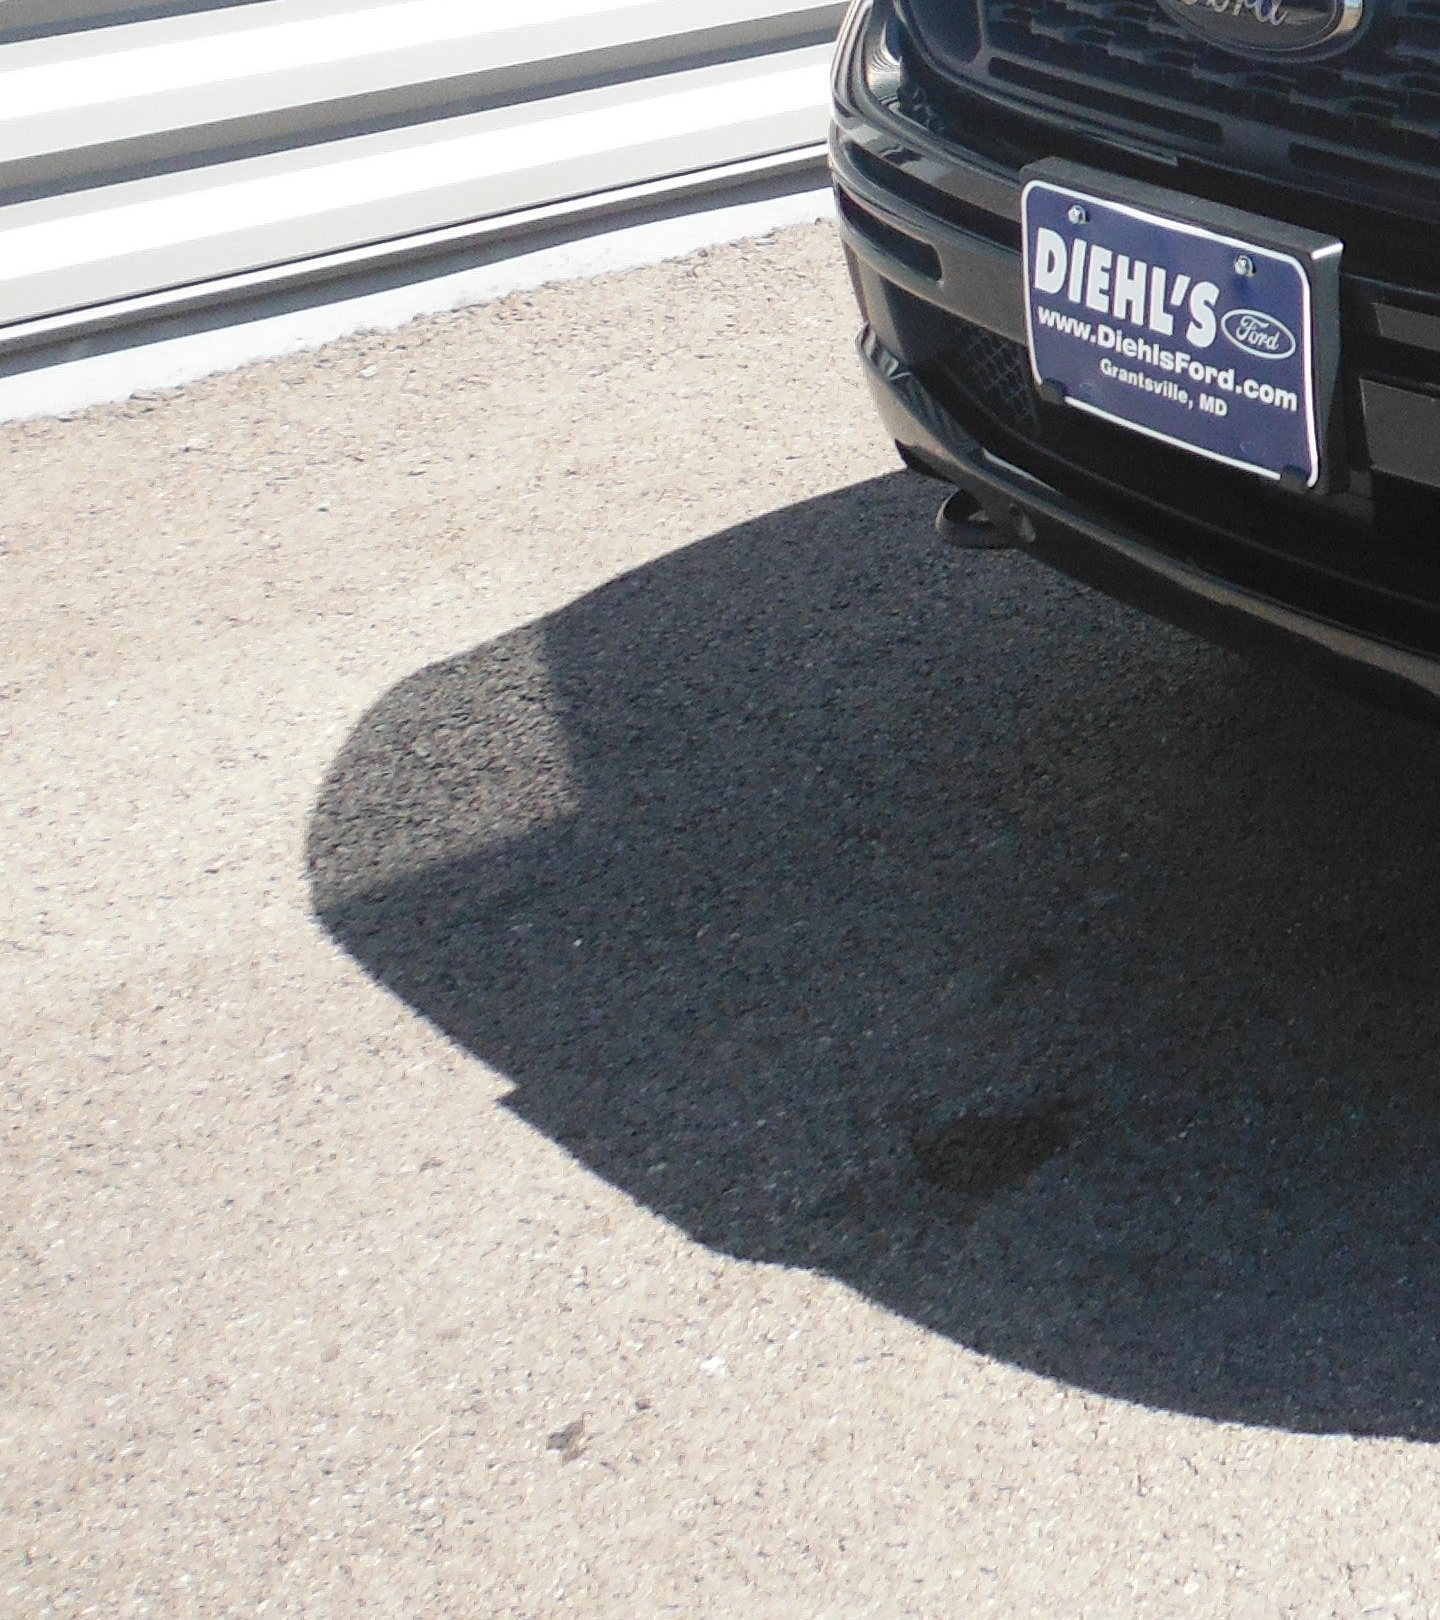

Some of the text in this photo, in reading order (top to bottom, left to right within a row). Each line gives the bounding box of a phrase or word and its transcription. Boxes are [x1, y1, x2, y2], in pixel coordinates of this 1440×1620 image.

[1034, 226, 1220, 349] DIEHL'S
[1037, 305, 1298, 412] www.DiehlsFord.com
[1234, 314, 1280, 352] Ford
[1099, 357, 1228, 417] Grantsville, MD
